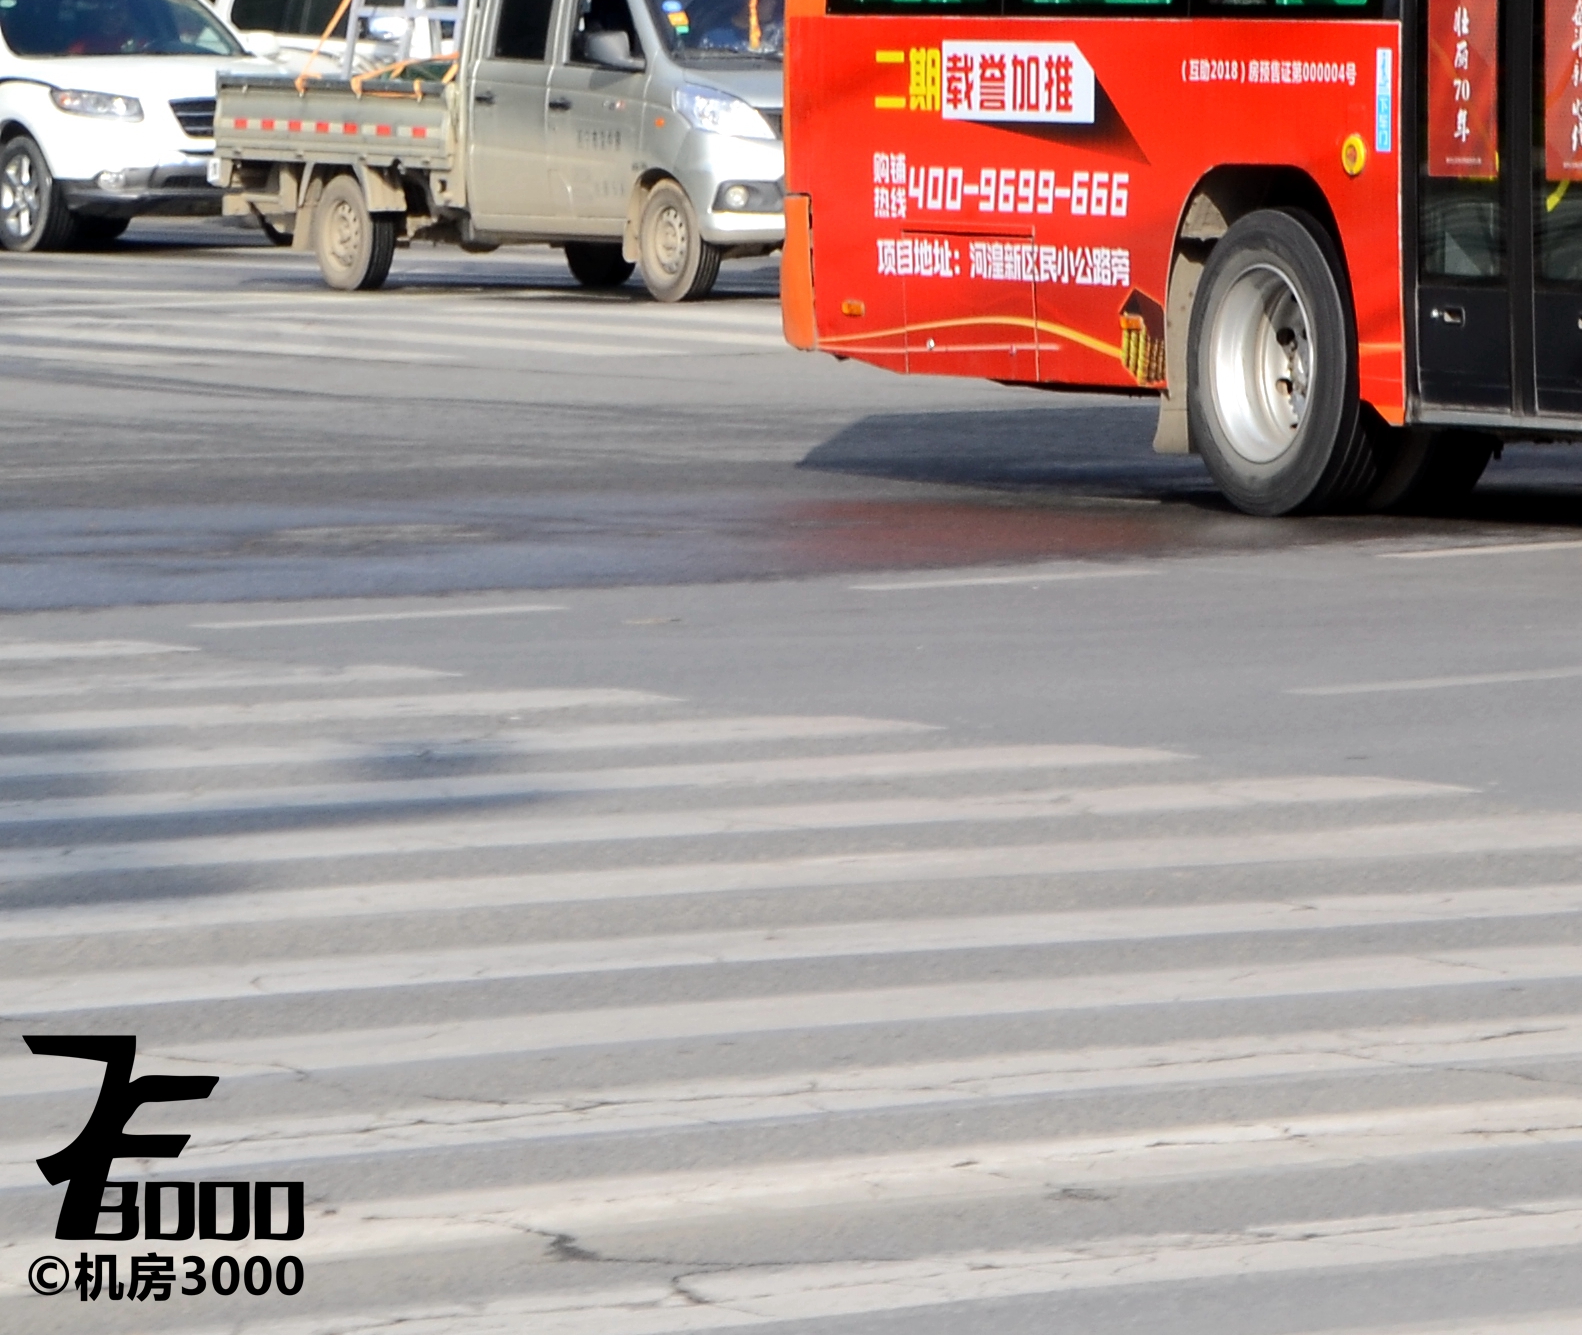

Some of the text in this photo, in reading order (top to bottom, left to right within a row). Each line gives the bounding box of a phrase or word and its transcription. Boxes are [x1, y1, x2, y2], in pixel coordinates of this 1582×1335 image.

[874, 48, 1074, 113] 二期载誉加推
[1453, 6, 1471, 142] 壮丽70年
[874, 187, 907, 219] 热线
[908, 166, 1129, 217] 400-9699-666
